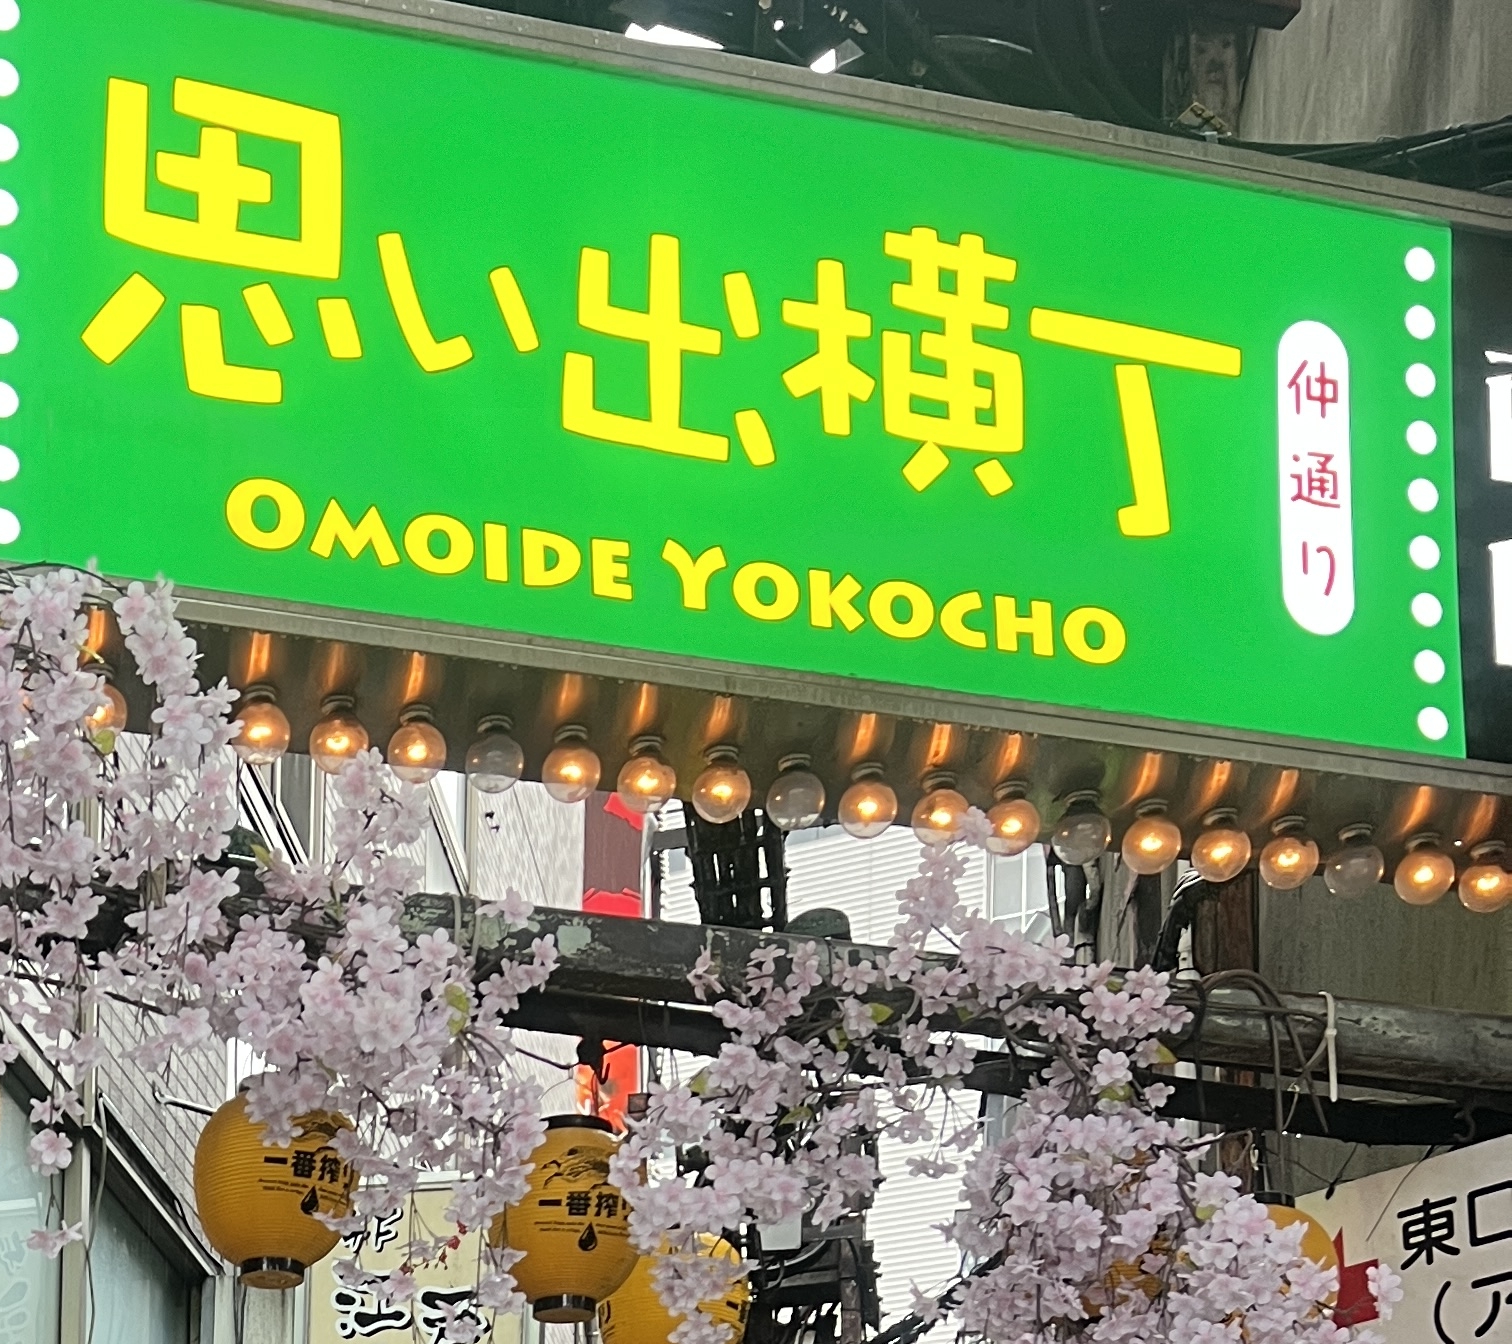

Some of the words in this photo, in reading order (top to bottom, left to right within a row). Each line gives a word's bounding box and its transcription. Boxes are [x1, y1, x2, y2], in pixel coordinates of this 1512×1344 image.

[80, 76, 1242, 539] 思い出横丁
[224, 476, 633, 600] OMOIDE
[662, 538, 1128, 665] YOKOCHO
[1287, 359, 1343, 598] 仲通り
